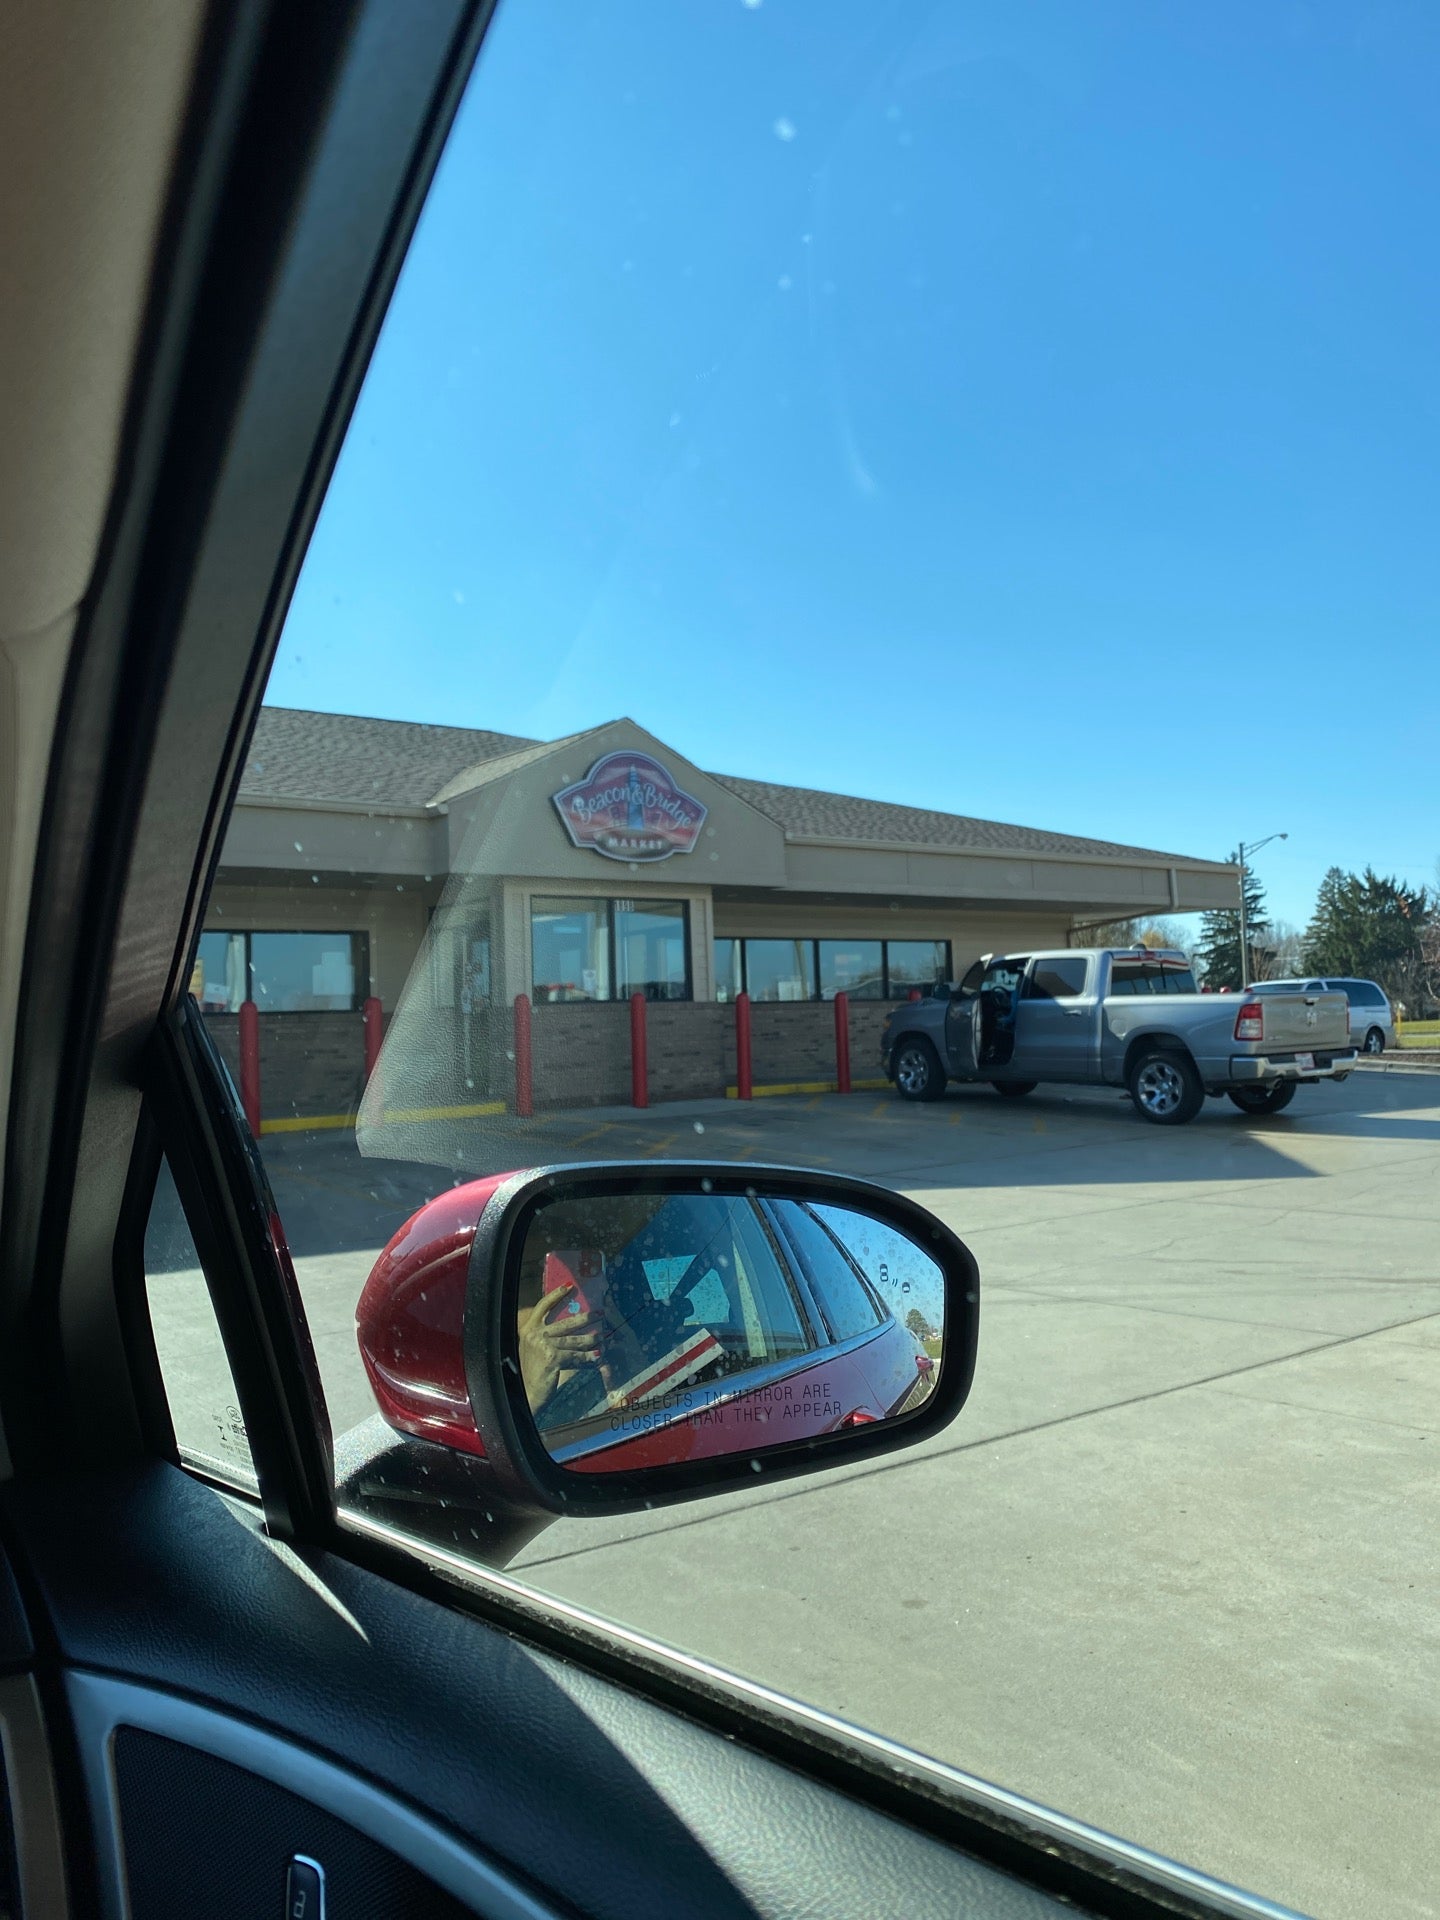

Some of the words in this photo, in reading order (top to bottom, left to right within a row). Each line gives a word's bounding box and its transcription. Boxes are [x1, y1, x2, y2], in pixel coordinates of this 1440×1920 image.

[572, 784, 630, 824] Beacon
[632, 782, 643, 805] &
[643, 782, 692, 830] Bridge
[608, 837, 662, 850] MARKET
[620, 1392, 693, 1412] OBJECTS
[705, 1391, 724, 1405] IN
[735, 1386, 793, 1404] MIRROR
[802, 1383, 831, 1398] ARE
[611, 1413, 672, 1431] CLOSER
[685, 1410, 723, 1425] THAN
[734, 1407, 772, 1422] THEY
[783, 1401, 842, 1418] APPEAR
